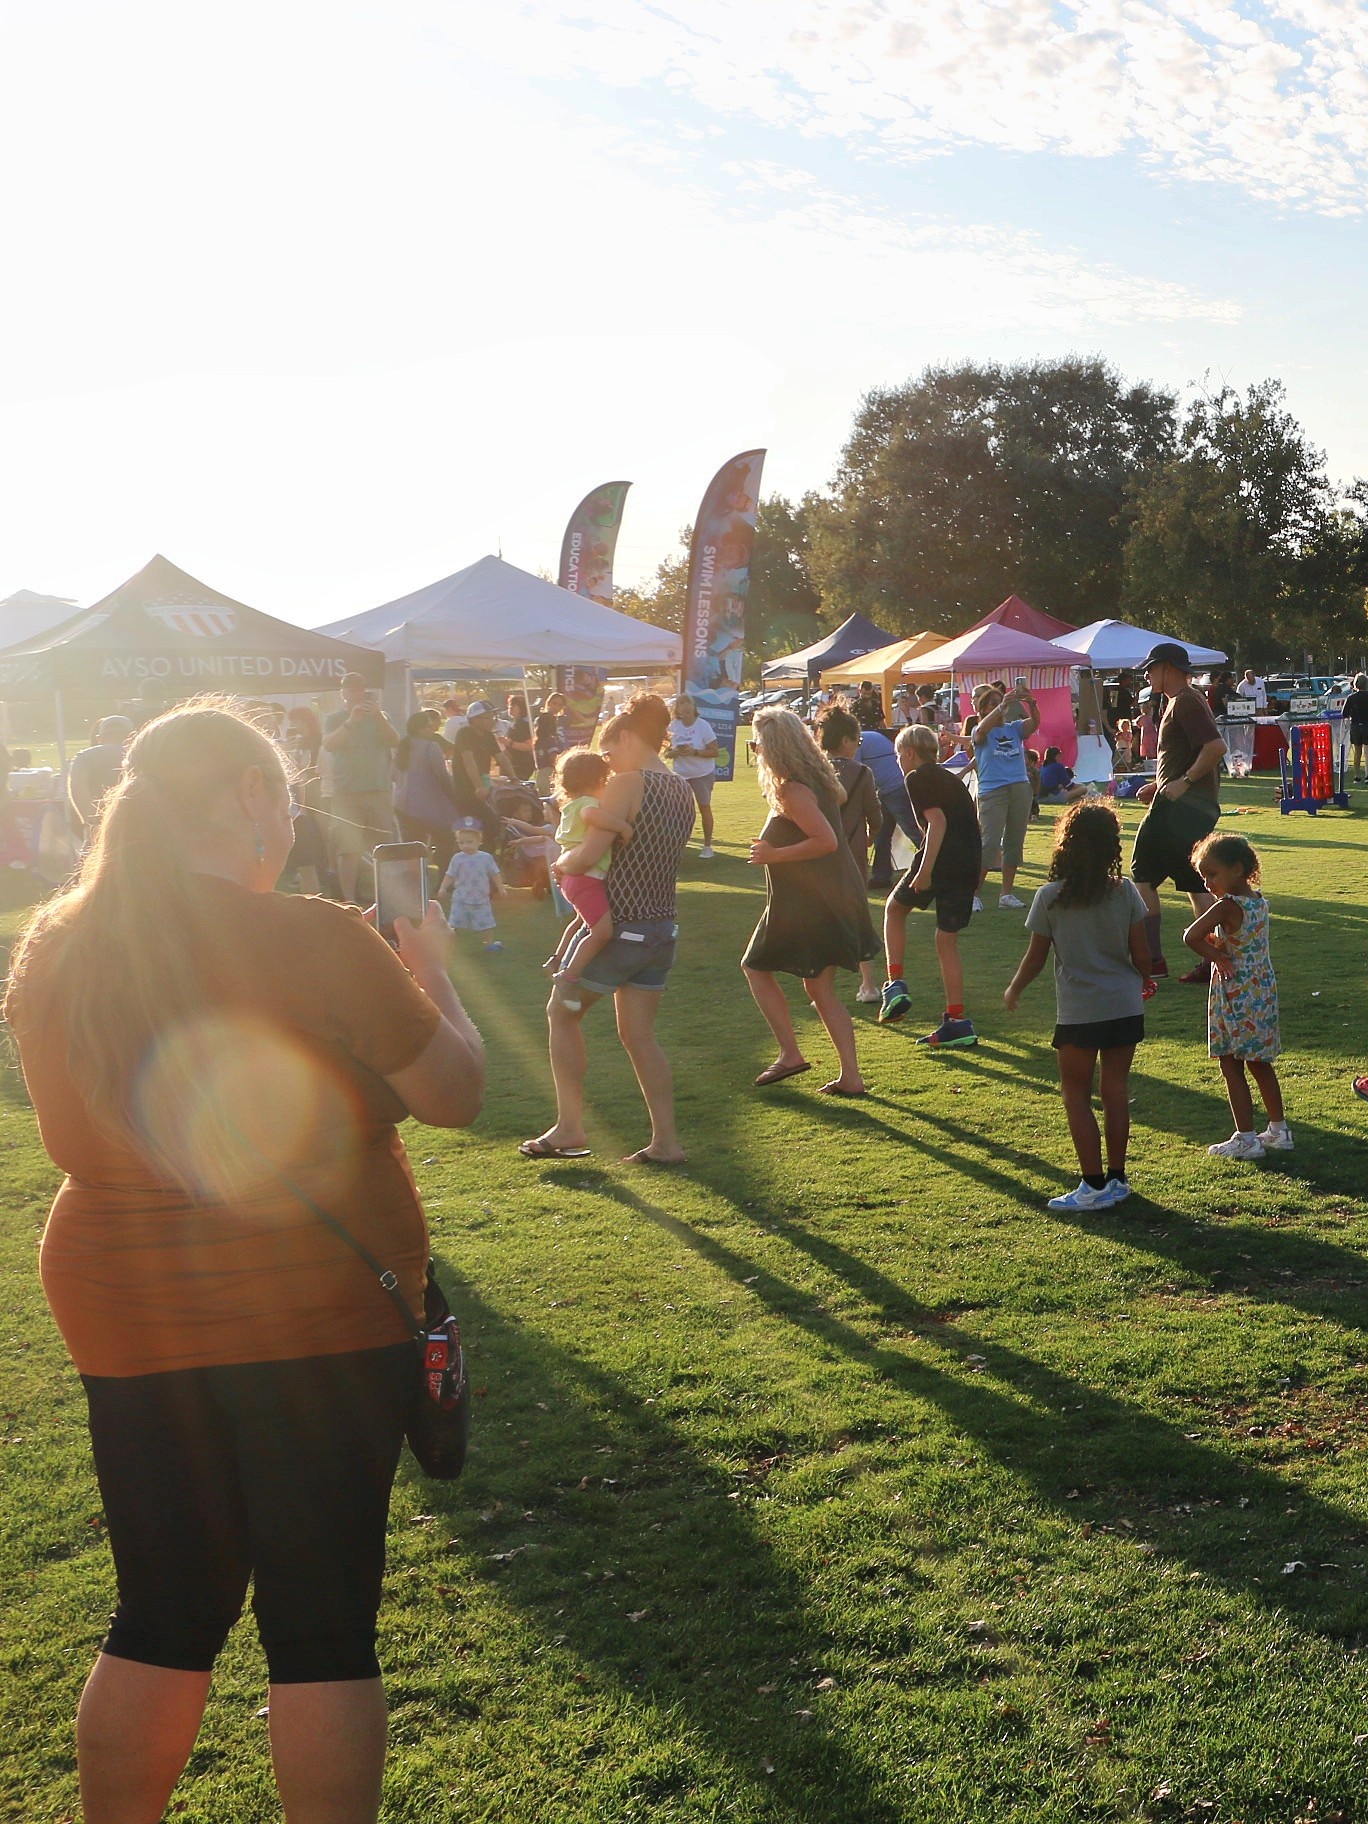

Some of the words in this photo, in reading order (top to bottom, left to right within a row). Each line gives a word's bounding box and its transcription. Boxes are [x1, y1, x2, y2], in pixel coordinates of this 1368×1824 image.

[567, 532, 583, 593] EDUCATIO
[699, 545, 717, 588] SWIM
[694, 590, 712, 659] LESSONS
[101, 656, 172, 677] AYSO
[178, 656, 274, 677] UNITED
[279, 657, 347, 678] DAVIS
